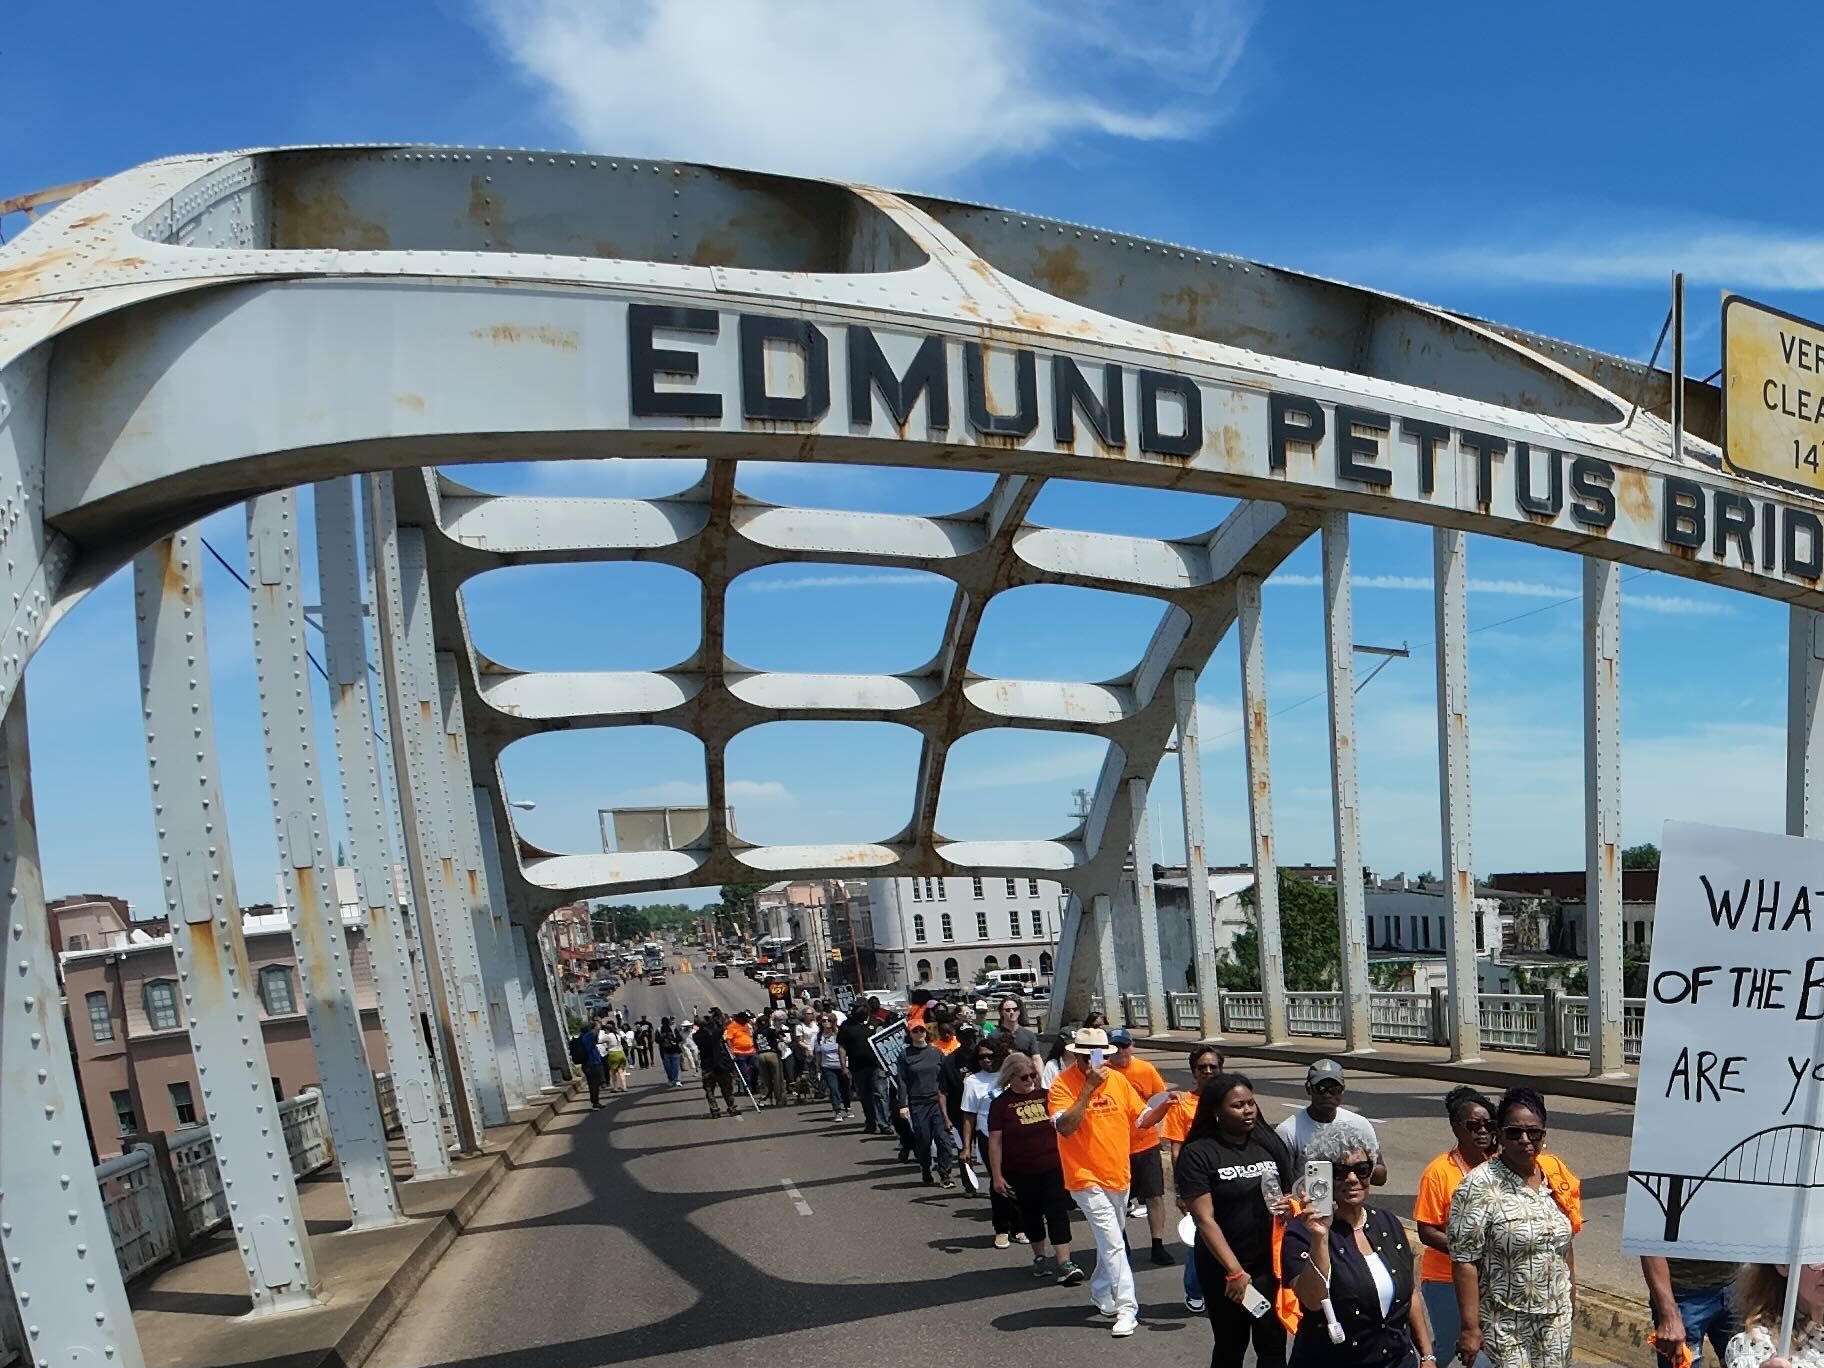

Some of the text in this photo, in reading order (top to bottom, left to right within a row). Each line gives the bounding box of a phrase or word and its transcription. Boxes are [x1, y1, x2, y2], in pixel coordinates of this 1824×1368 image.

[628, 304, 1203, 457] EDMUND
[1268, 391, 1616, 529] PETTUS
[1653, 965, 1722, 1004] OF
[1729, 966, 1791, 1010] THE
[1665, 1046, 1747, 1103] ARE
